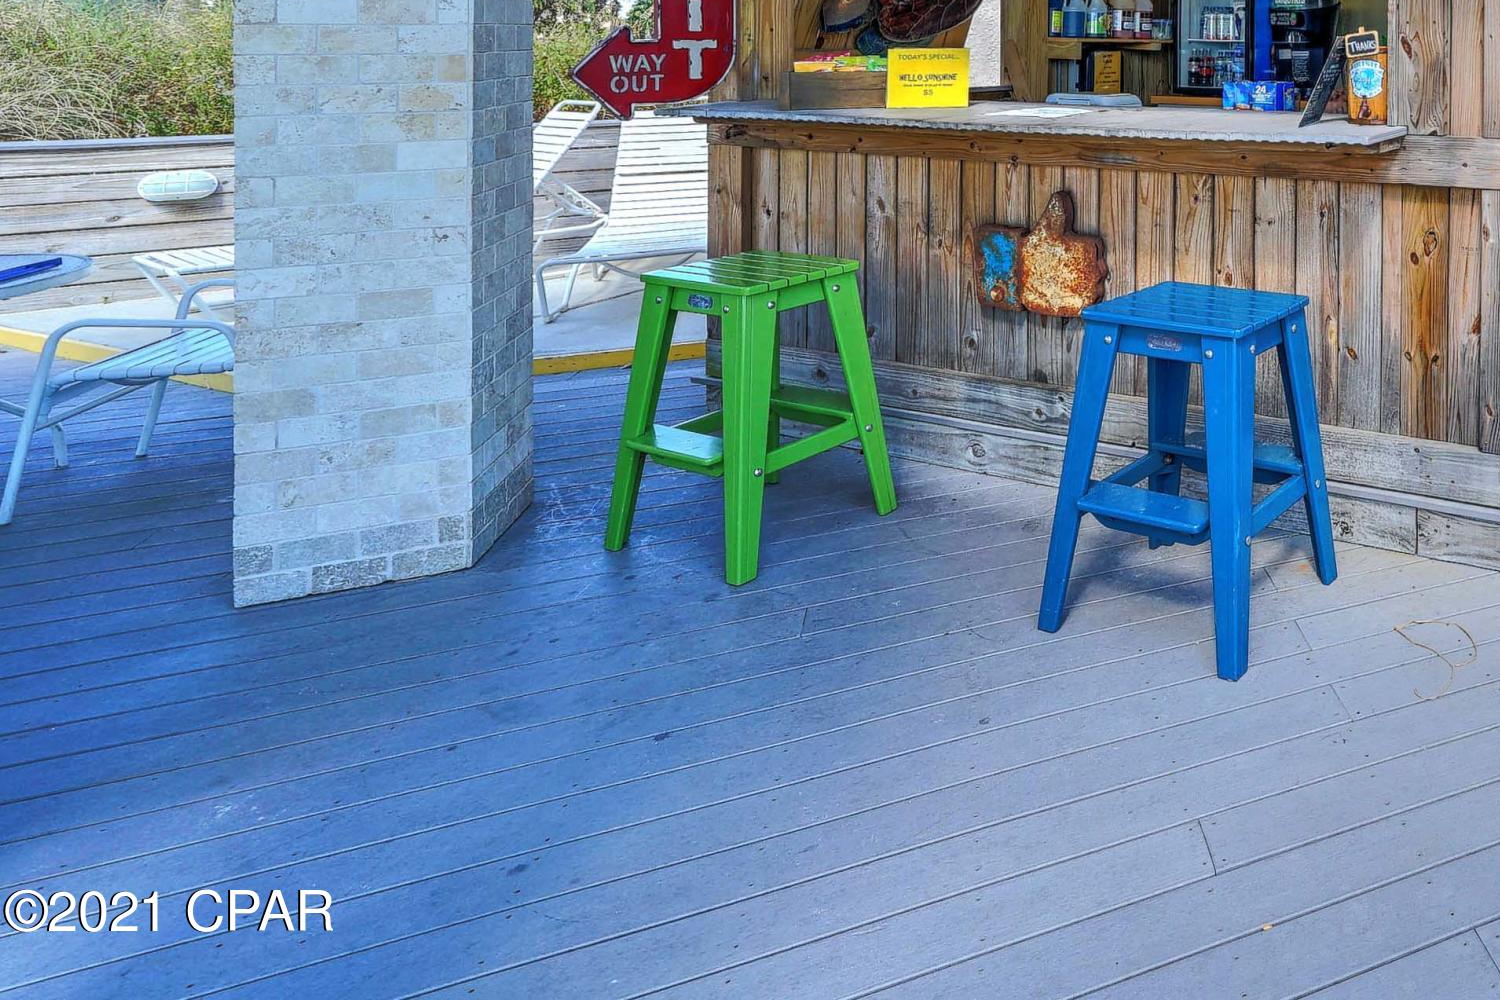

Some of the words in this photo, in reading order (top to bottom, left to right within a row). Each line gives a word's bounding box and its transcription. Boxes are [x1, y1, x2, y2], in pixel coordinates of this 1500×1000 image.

[1350, 40, 1377, 52] THANKS
[898, 53, 927, 61] TODAY'S
[609, 54, 667, 74] WAY
[898, 73, 923, 82] HELLO
[610, 74, 665, 94] OUT
[1255, 84, 1267, 94] 24
